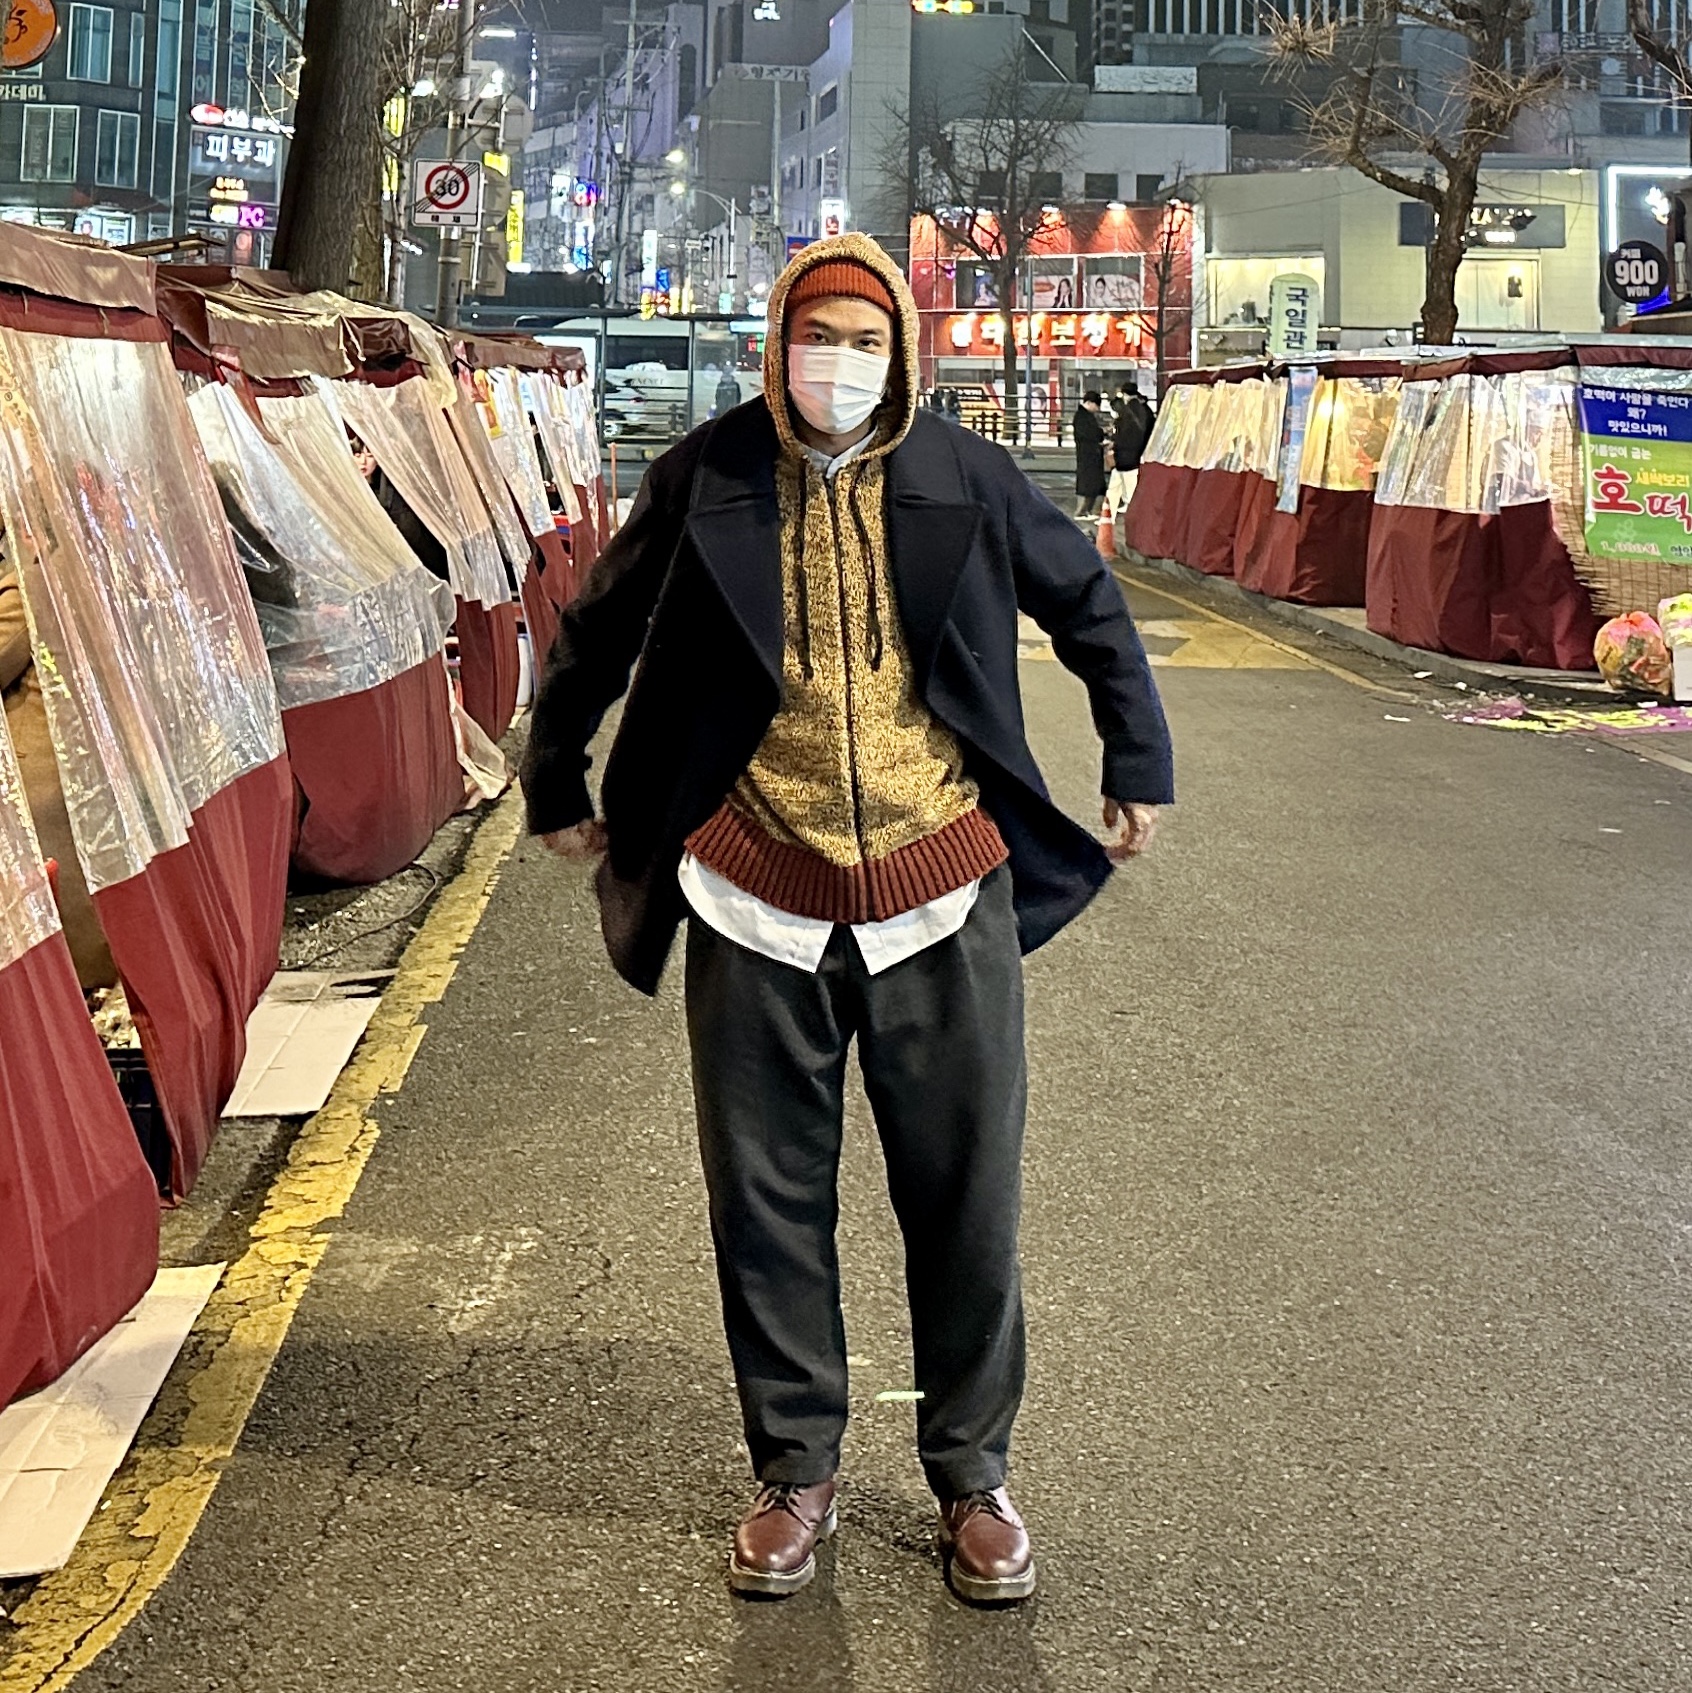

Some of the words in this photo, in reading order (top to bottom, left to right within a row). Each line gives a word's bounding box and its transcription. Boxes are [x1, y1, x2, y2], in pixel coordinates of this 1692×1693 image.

[206, 135, 276, 167] 피부과
[435, 180, 460, 197] 30
[239, 206, 265, 227] PC
[1614, 259, 1659, 286] 900
[1626, 285, 1650, 297] WON
[1283, 286, 1310, 350] 국일관
[1583, 388, 1616, 403] 호떡이
[1620, 392, 1652, 406] 사람을
[1657, 394, 1689, 409] 죽인다
[1608, 420, 1668, 437] 맛있으니까!
